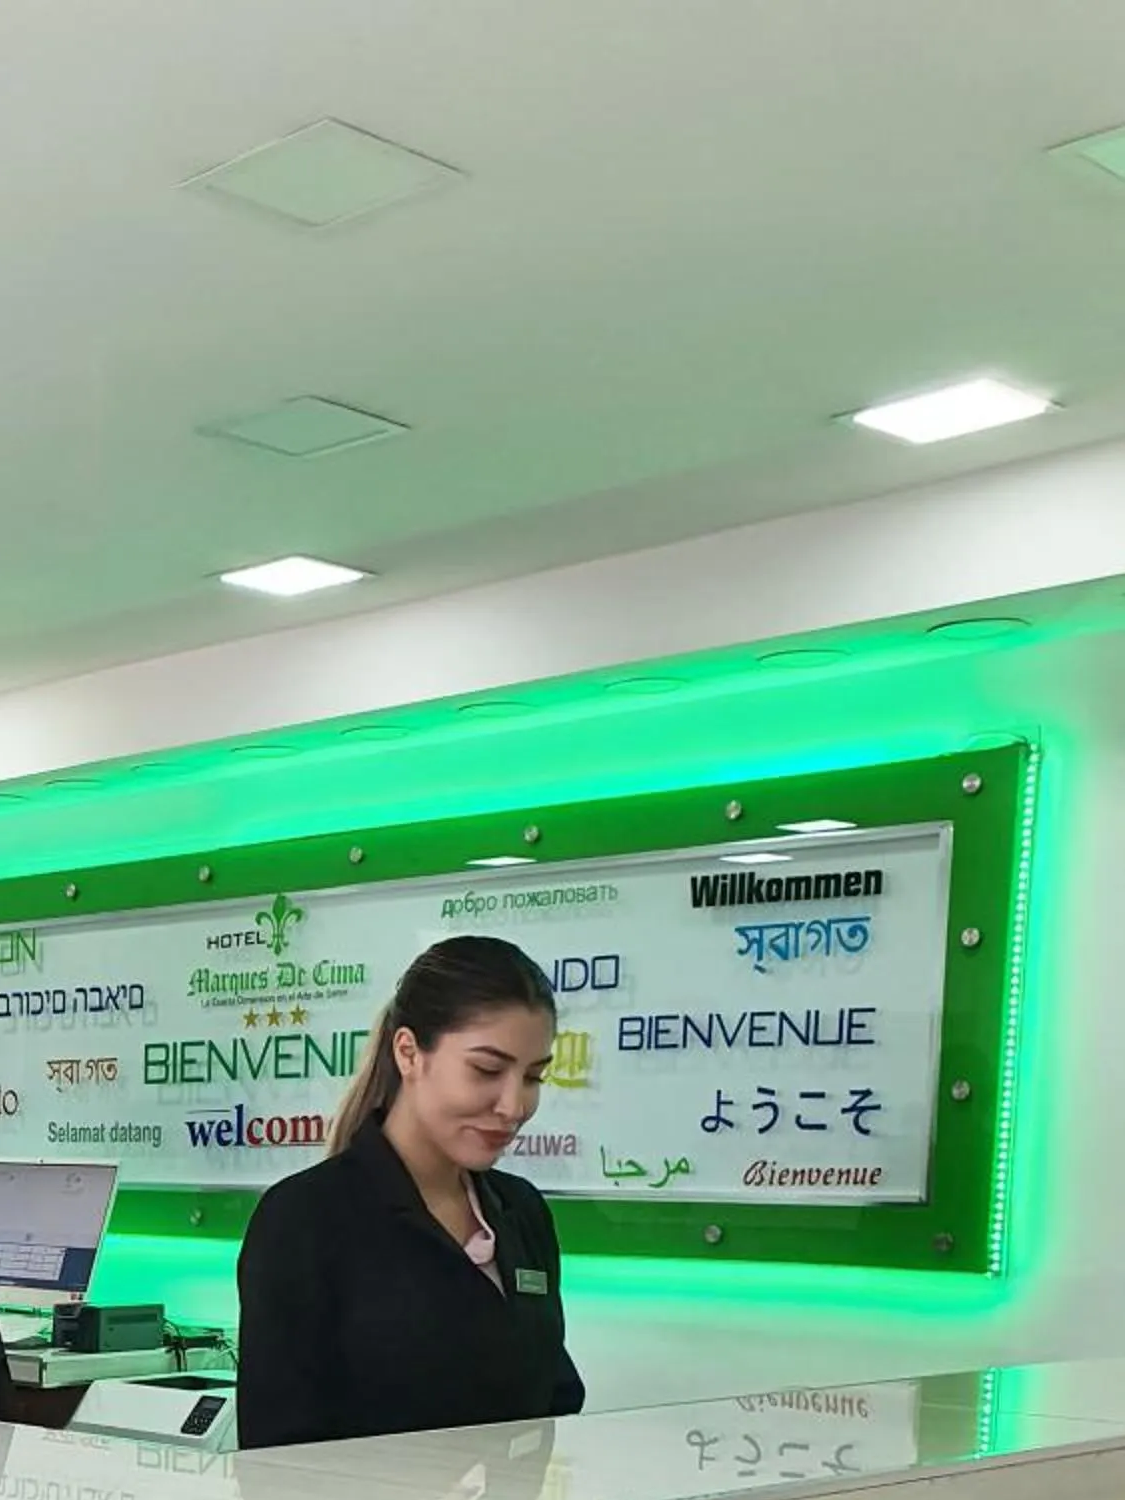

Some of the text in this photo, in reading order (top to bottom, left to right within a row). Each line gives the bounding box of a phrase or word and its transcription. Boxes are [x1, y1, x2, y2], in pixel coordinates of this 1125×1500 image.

[441, 884, 618, 918] добро пожаловать
[690, 870, 883, 908] Willkommen
[206, 931, 267, 950] HOTEL
[187, 960, 365, 997] Marques De Cima
[618, 1007, 876, 1051] BIENVENUE
[700, 1085, 882, 1135] ようこそ
[48, 1121, 162, 1147] Selamat datang
[513, 1133, 577, 1157] zuwa
[600, 1145, 690, 1188] مرحبا
[743, 1160, 882, 1187] Bienvenue
